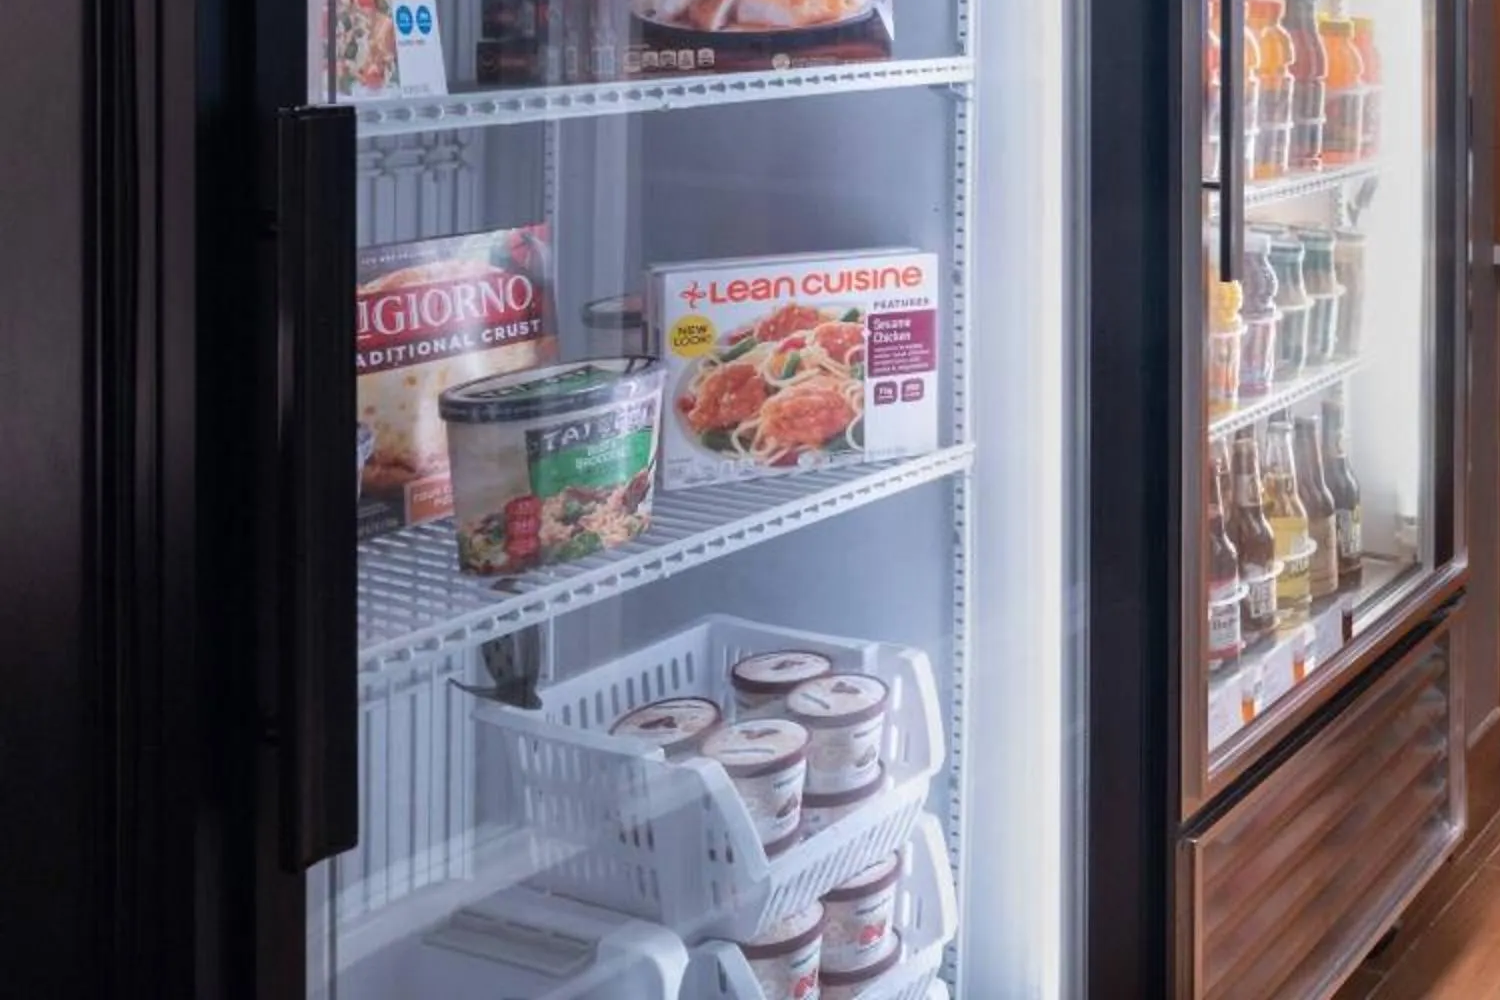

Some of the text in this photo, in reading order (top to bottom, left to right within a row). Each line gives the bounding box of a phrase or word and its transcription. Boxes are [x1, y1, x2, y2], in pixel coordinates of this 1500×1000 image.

[357, 275, 533, 335] IGIORNO
[709, 275, 796, 305] Lean
[356, 319, 541, 369] ADITIONAL CRUST
[678, 324, 708, 336] NEW
